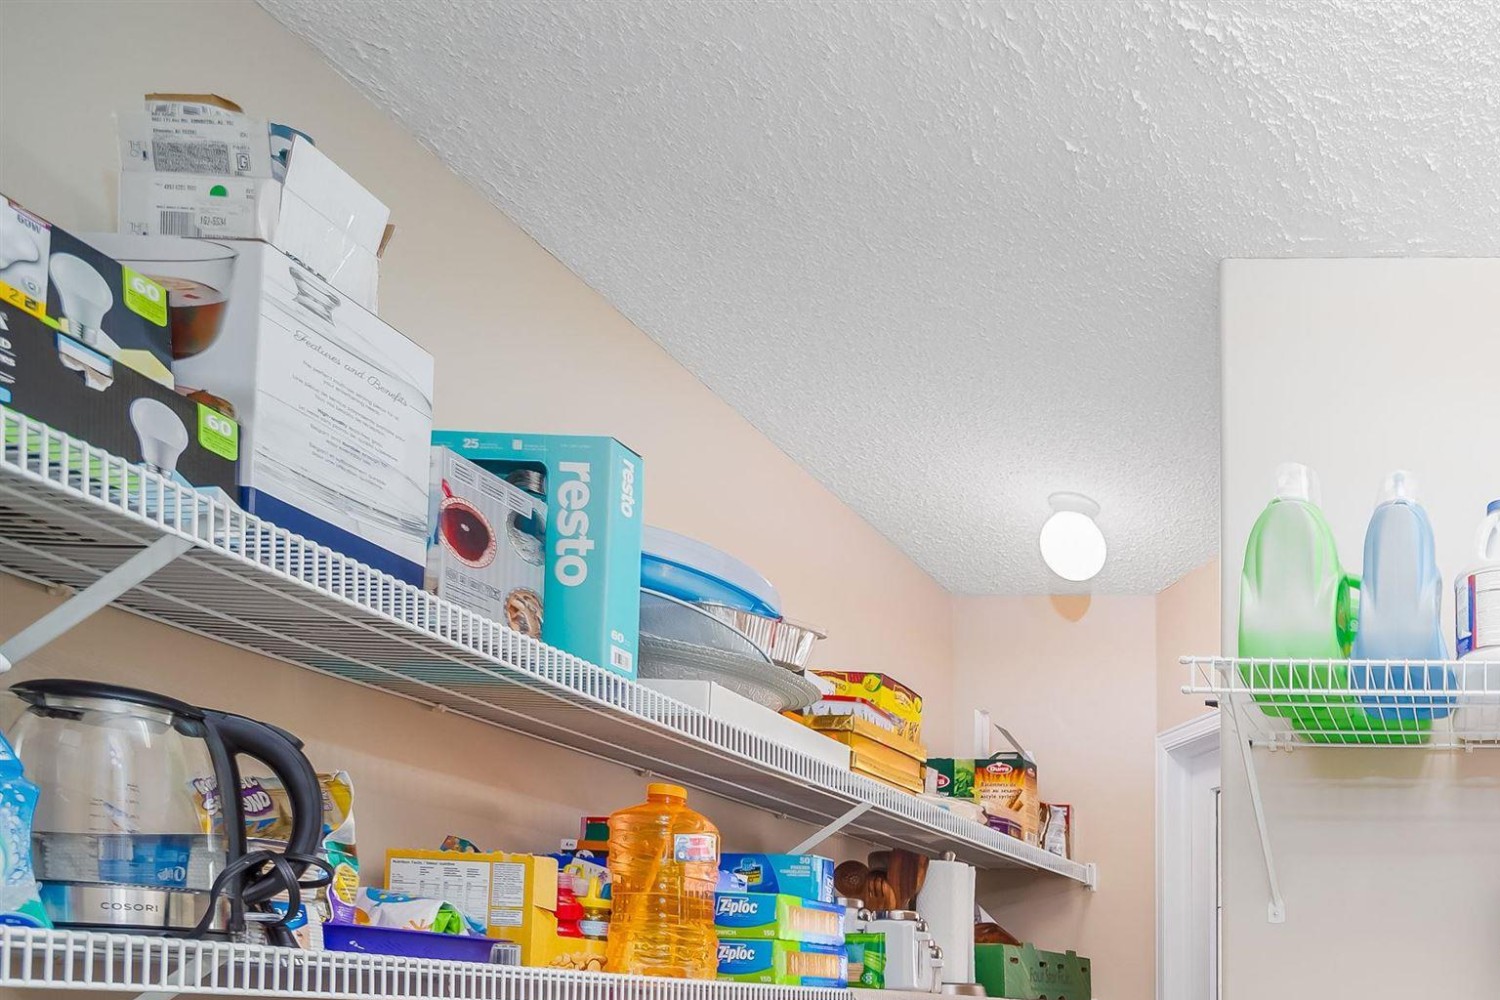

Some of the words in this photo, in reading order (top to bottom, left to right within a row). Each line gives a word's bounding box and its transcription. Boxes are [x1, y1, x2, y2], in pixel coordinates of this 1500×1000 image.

[130, 276, 160, 303] 60
[293, 330, 341, 366] Features
[344, 364, 366, 380] and
[367, 376, 408, 407] Benefits
[205, 413, 231, 437] 60
[462, 438, 480, 449] 25
[621, 458, 635, 519] resto
[554, 461, 595, 588] resto
[610, 629, 624, 643] 60
[824, 874, 835, 903] Ziplo
[100, 901, 159, 912] COSORI
[720, 898, 758, 916] Ziploc
[718, 945, 756, 963] Ziploc
